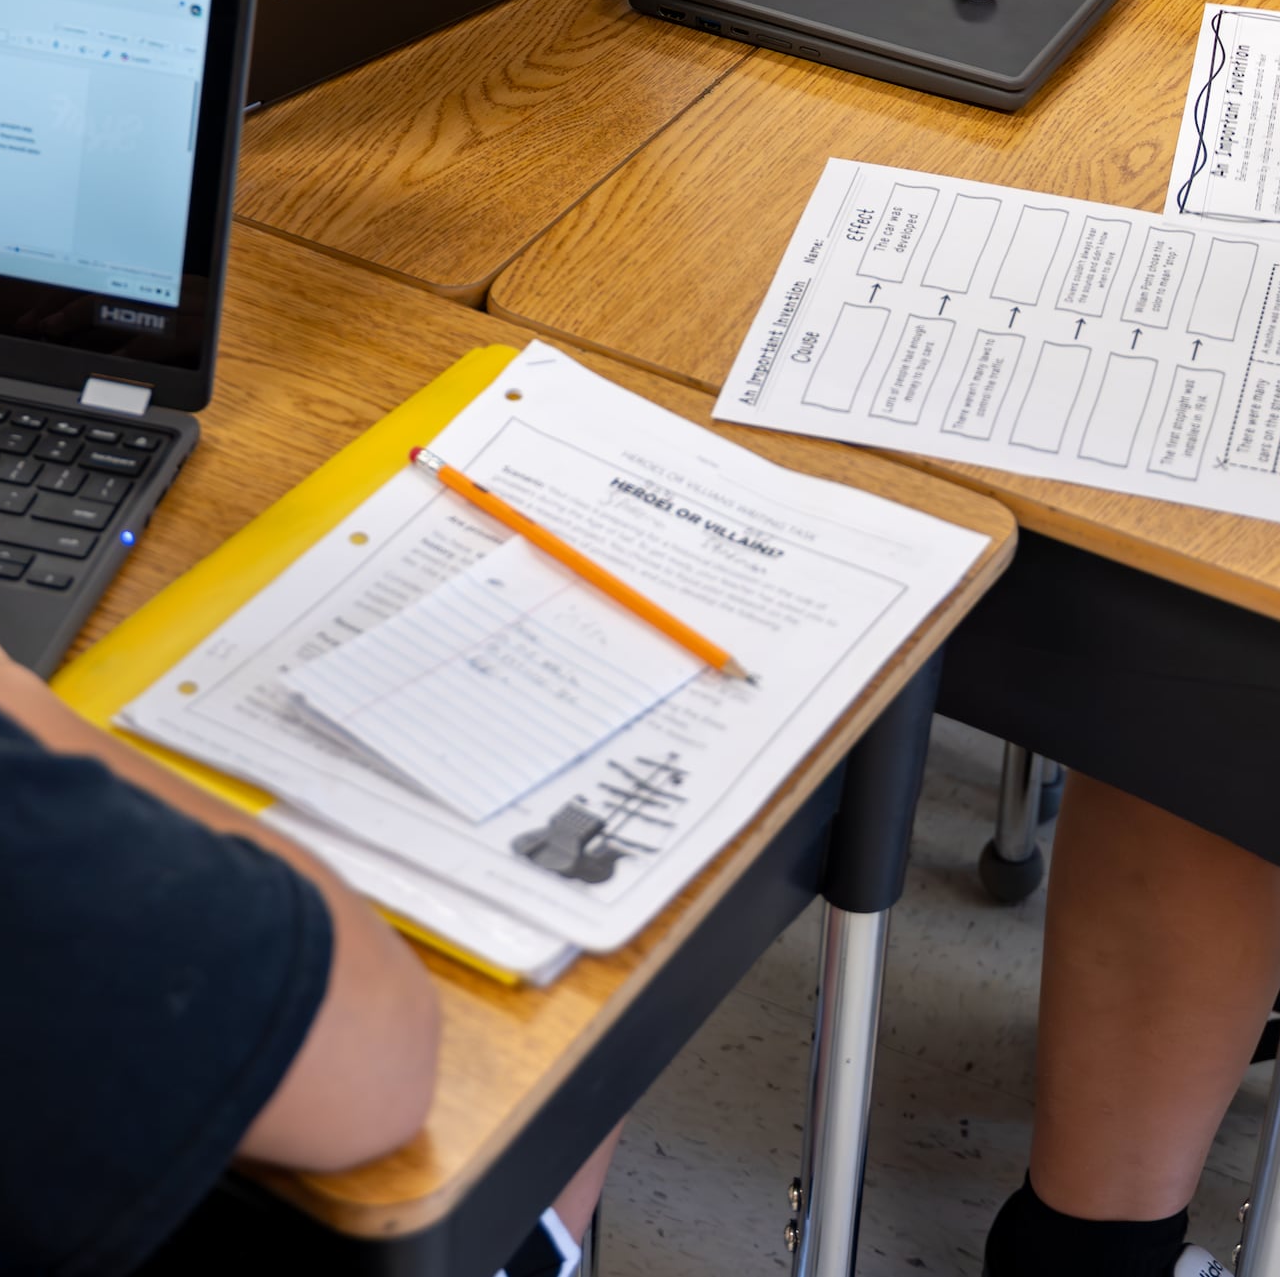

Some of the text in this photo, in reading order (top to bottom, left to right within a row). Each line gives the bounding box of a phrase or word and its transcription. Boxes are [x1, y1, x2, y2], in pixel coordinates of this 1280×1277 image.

[1209, 43, 1251, 178] An Important Invention
[846, 208, 874, 241] Effect
[872, 206, 902, 250] The car was
[1153, 240, 1164, 252] this
[1148, 253, 1161, 272] chose
[1151, 295, 1163, 312] color
[1159, 269, 1170, 287] mean
[100, 304, 166, 330] HDMI
[745, 329, 784, 386] Important
[772, 279, 806, 328] Invention
[790, 331, 819, 363] Cause
[1159, 379, 1195, 464] The first stoplight was
[1235, 378, 1269, 452] There were many
[1183, 422, 1200, 457] installed
[1257, 442, 1272, 462] cars
[1265, 412, 1279, 427] the
[610, 477, 674, 513] HEROES
[674, 506, 703, 525] OR
